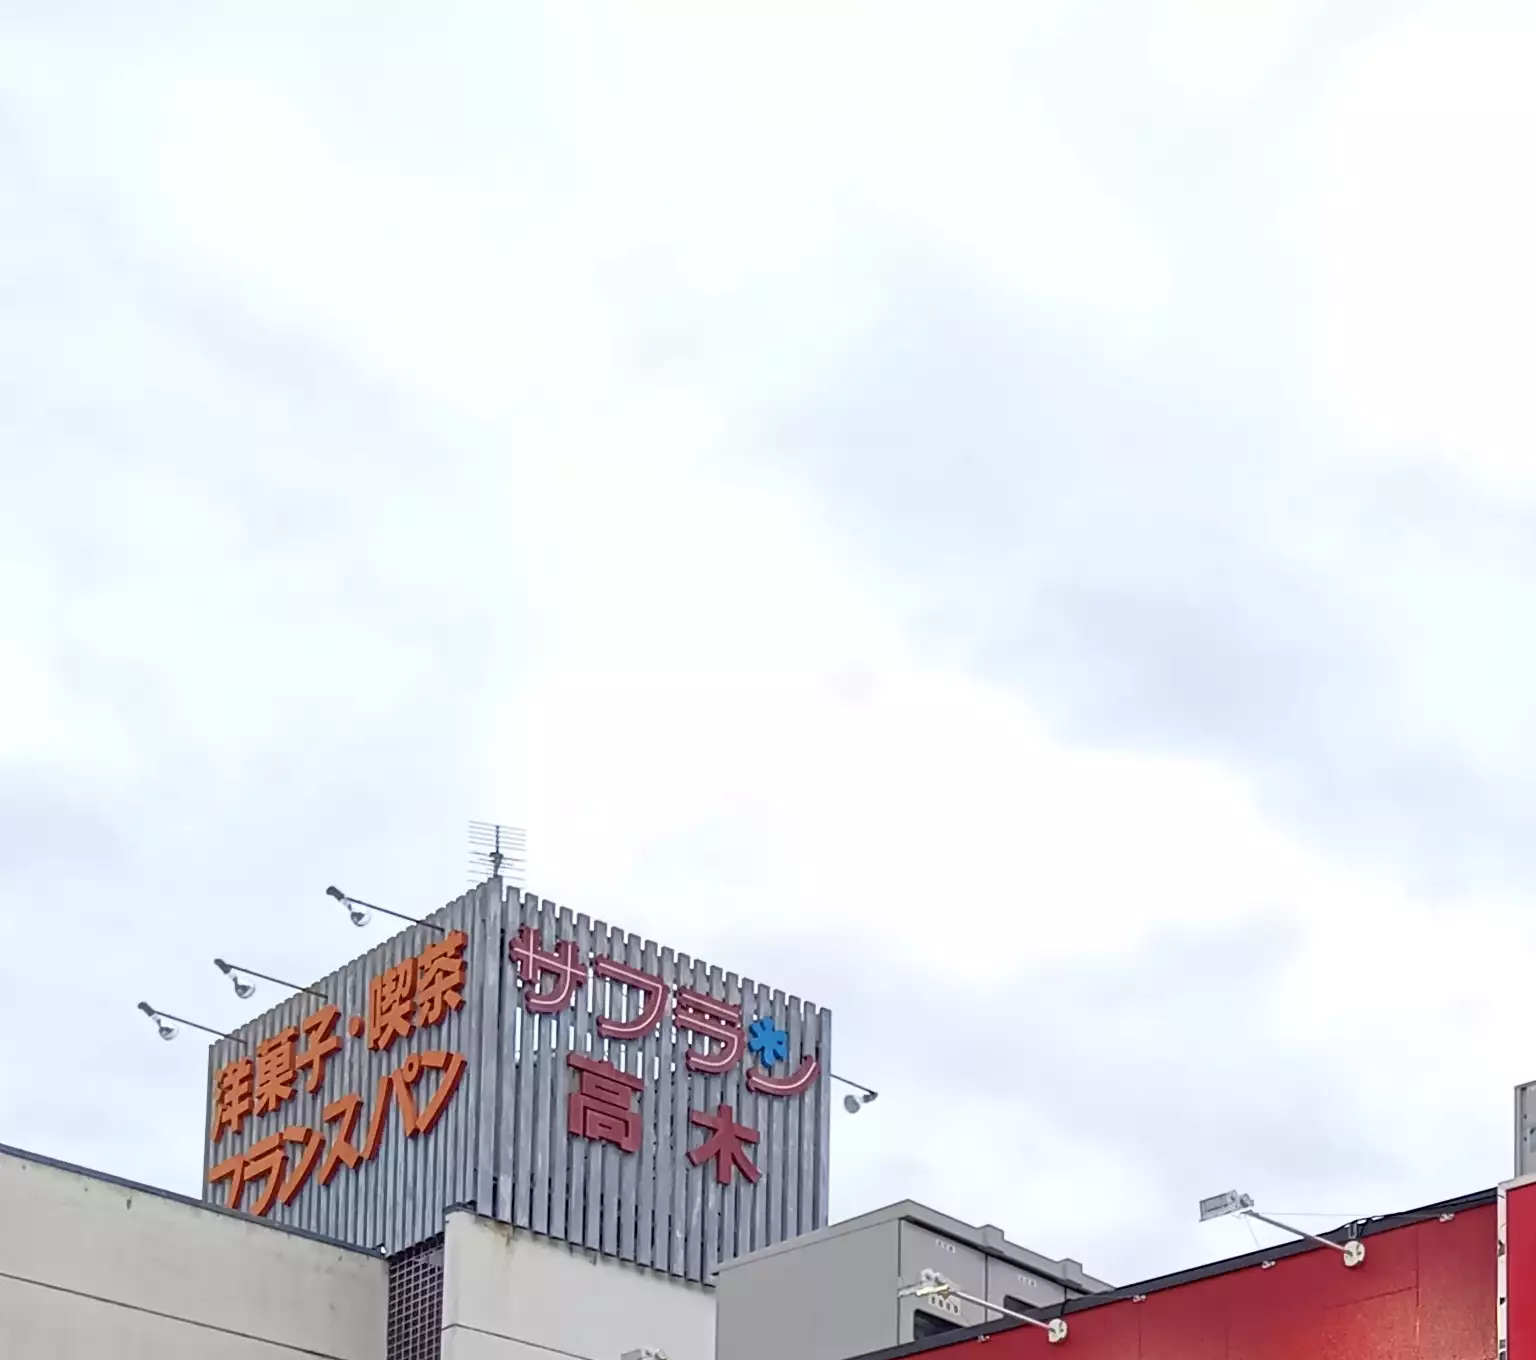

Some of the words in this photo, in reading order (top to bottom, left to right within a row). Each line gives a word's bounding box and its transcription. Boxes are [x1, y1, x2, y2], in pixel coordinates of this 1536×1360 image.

[210, 928, 468, 1143] 洋菓子・喫茶
[509, 923, 821, 1099] サフラン
[208, 1051, 467, 1216] フランスパン
[565, 1052, 763, 1186] 高木
